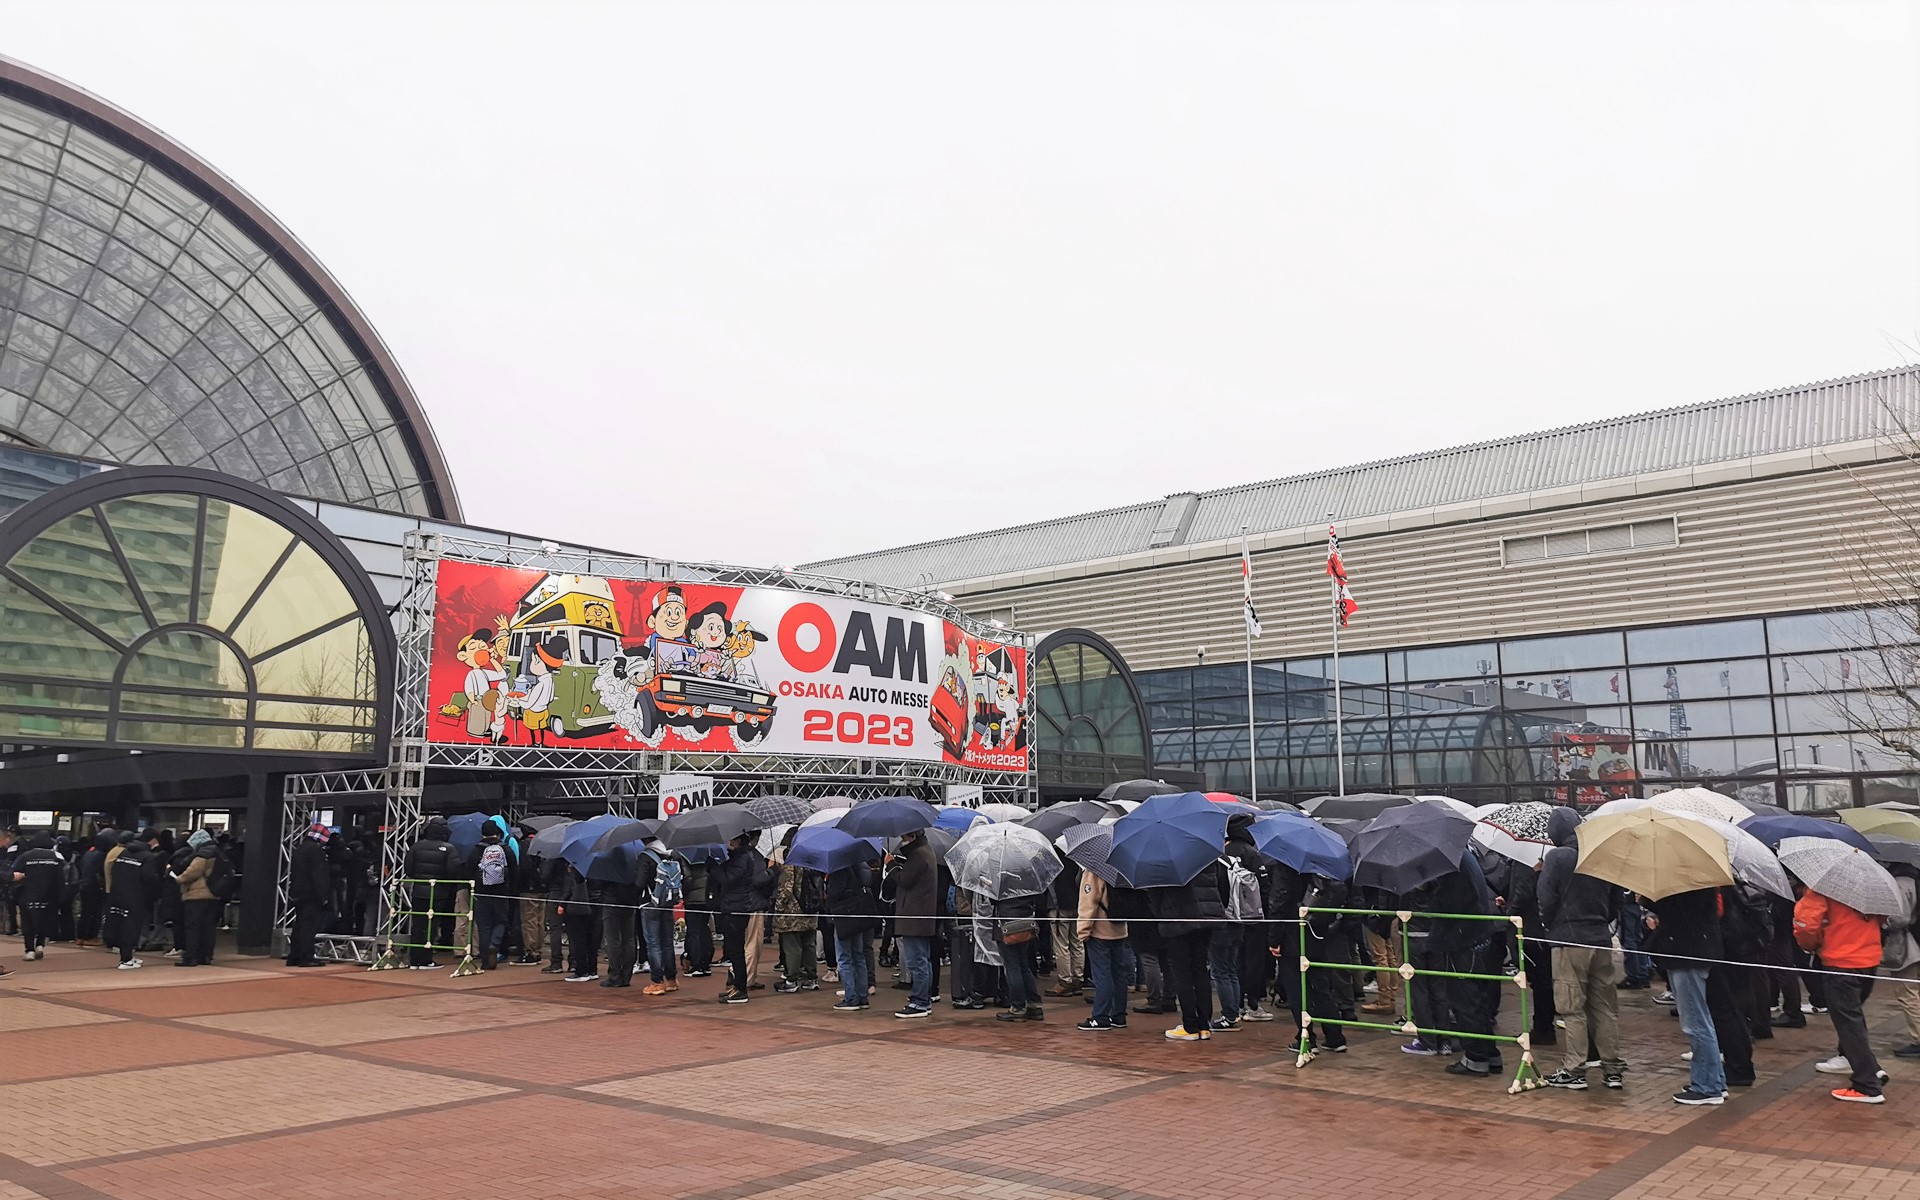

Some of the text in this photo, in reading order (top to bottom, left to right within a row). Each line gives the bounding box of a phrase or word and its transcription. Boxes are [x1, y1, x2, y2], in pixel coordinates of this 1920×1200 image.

[777, 602, 928, 684] OAM
[779, 681, 929, 708] OSAKA AUTO MESSE
[803, 709, 914, 747] 2023
[664, 790, 710, 815] OAM
